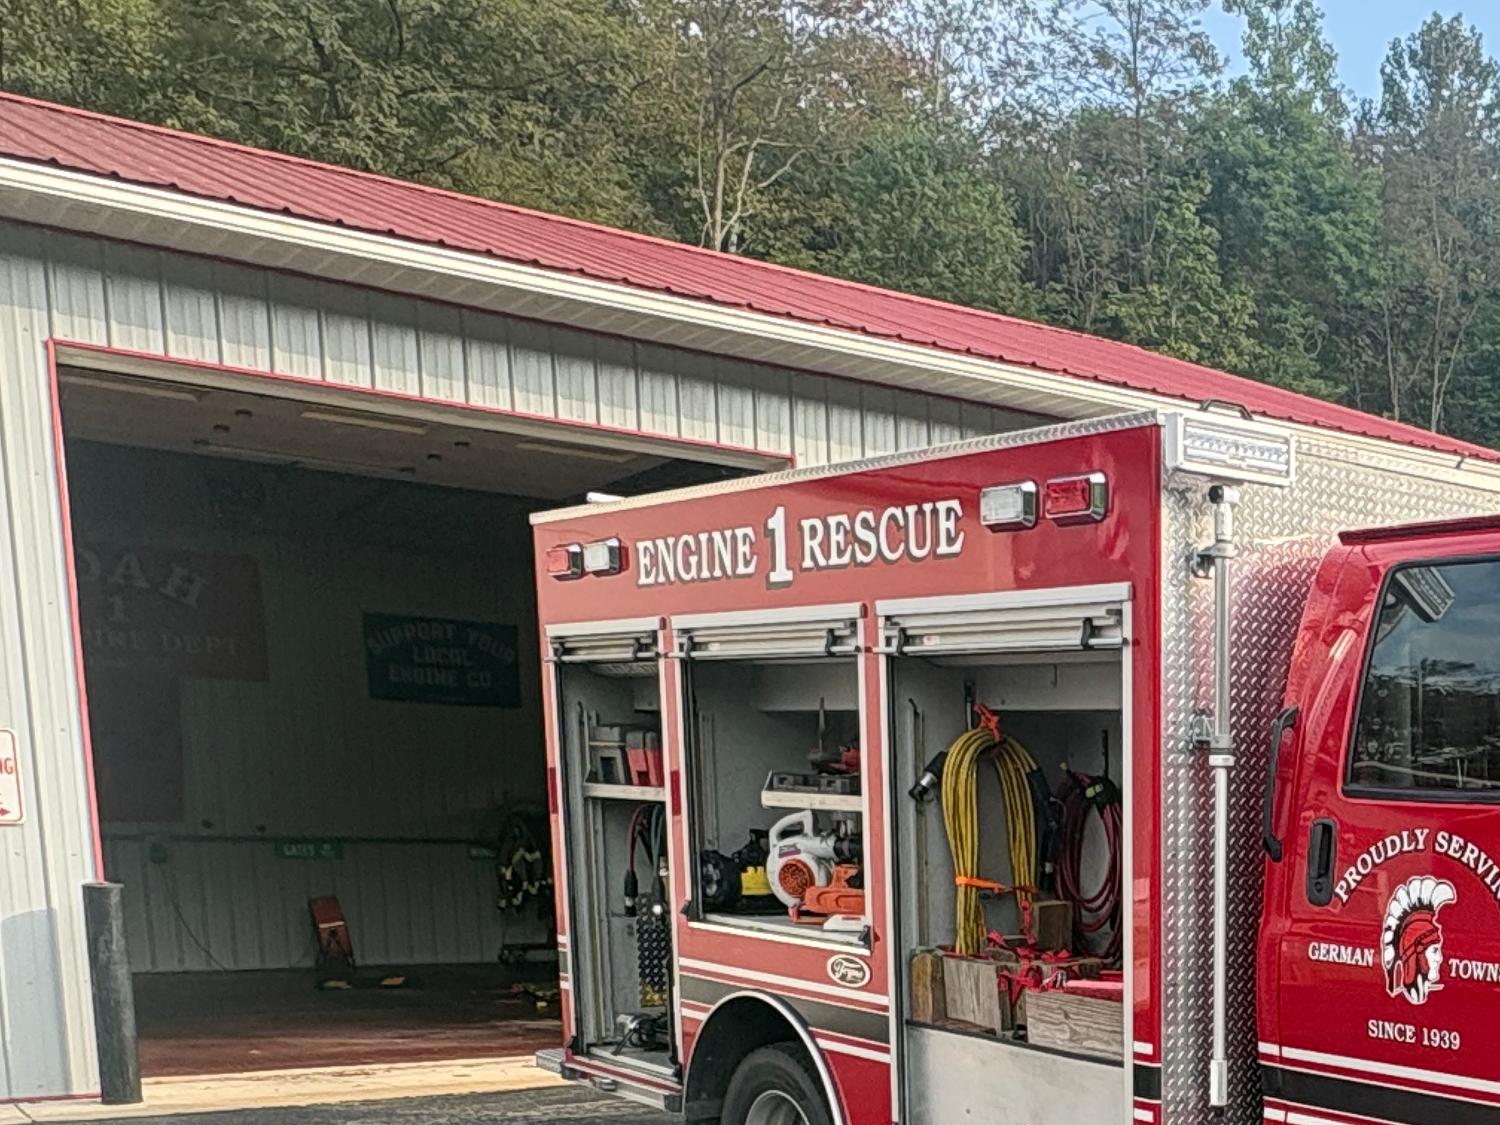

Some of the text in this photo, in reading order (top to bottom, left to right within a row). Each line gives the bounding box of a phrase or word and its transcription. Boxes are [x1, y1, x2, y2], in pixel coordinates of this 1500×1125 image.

[636, 500, 964, 585] ENGINE 1 RESCUE
[1335, 829, 1429, 903] PROUDLY
[1308, 942, 1375, 967] GERMAN
[1368, 1019, 1460, 1050] SINCE 1939
